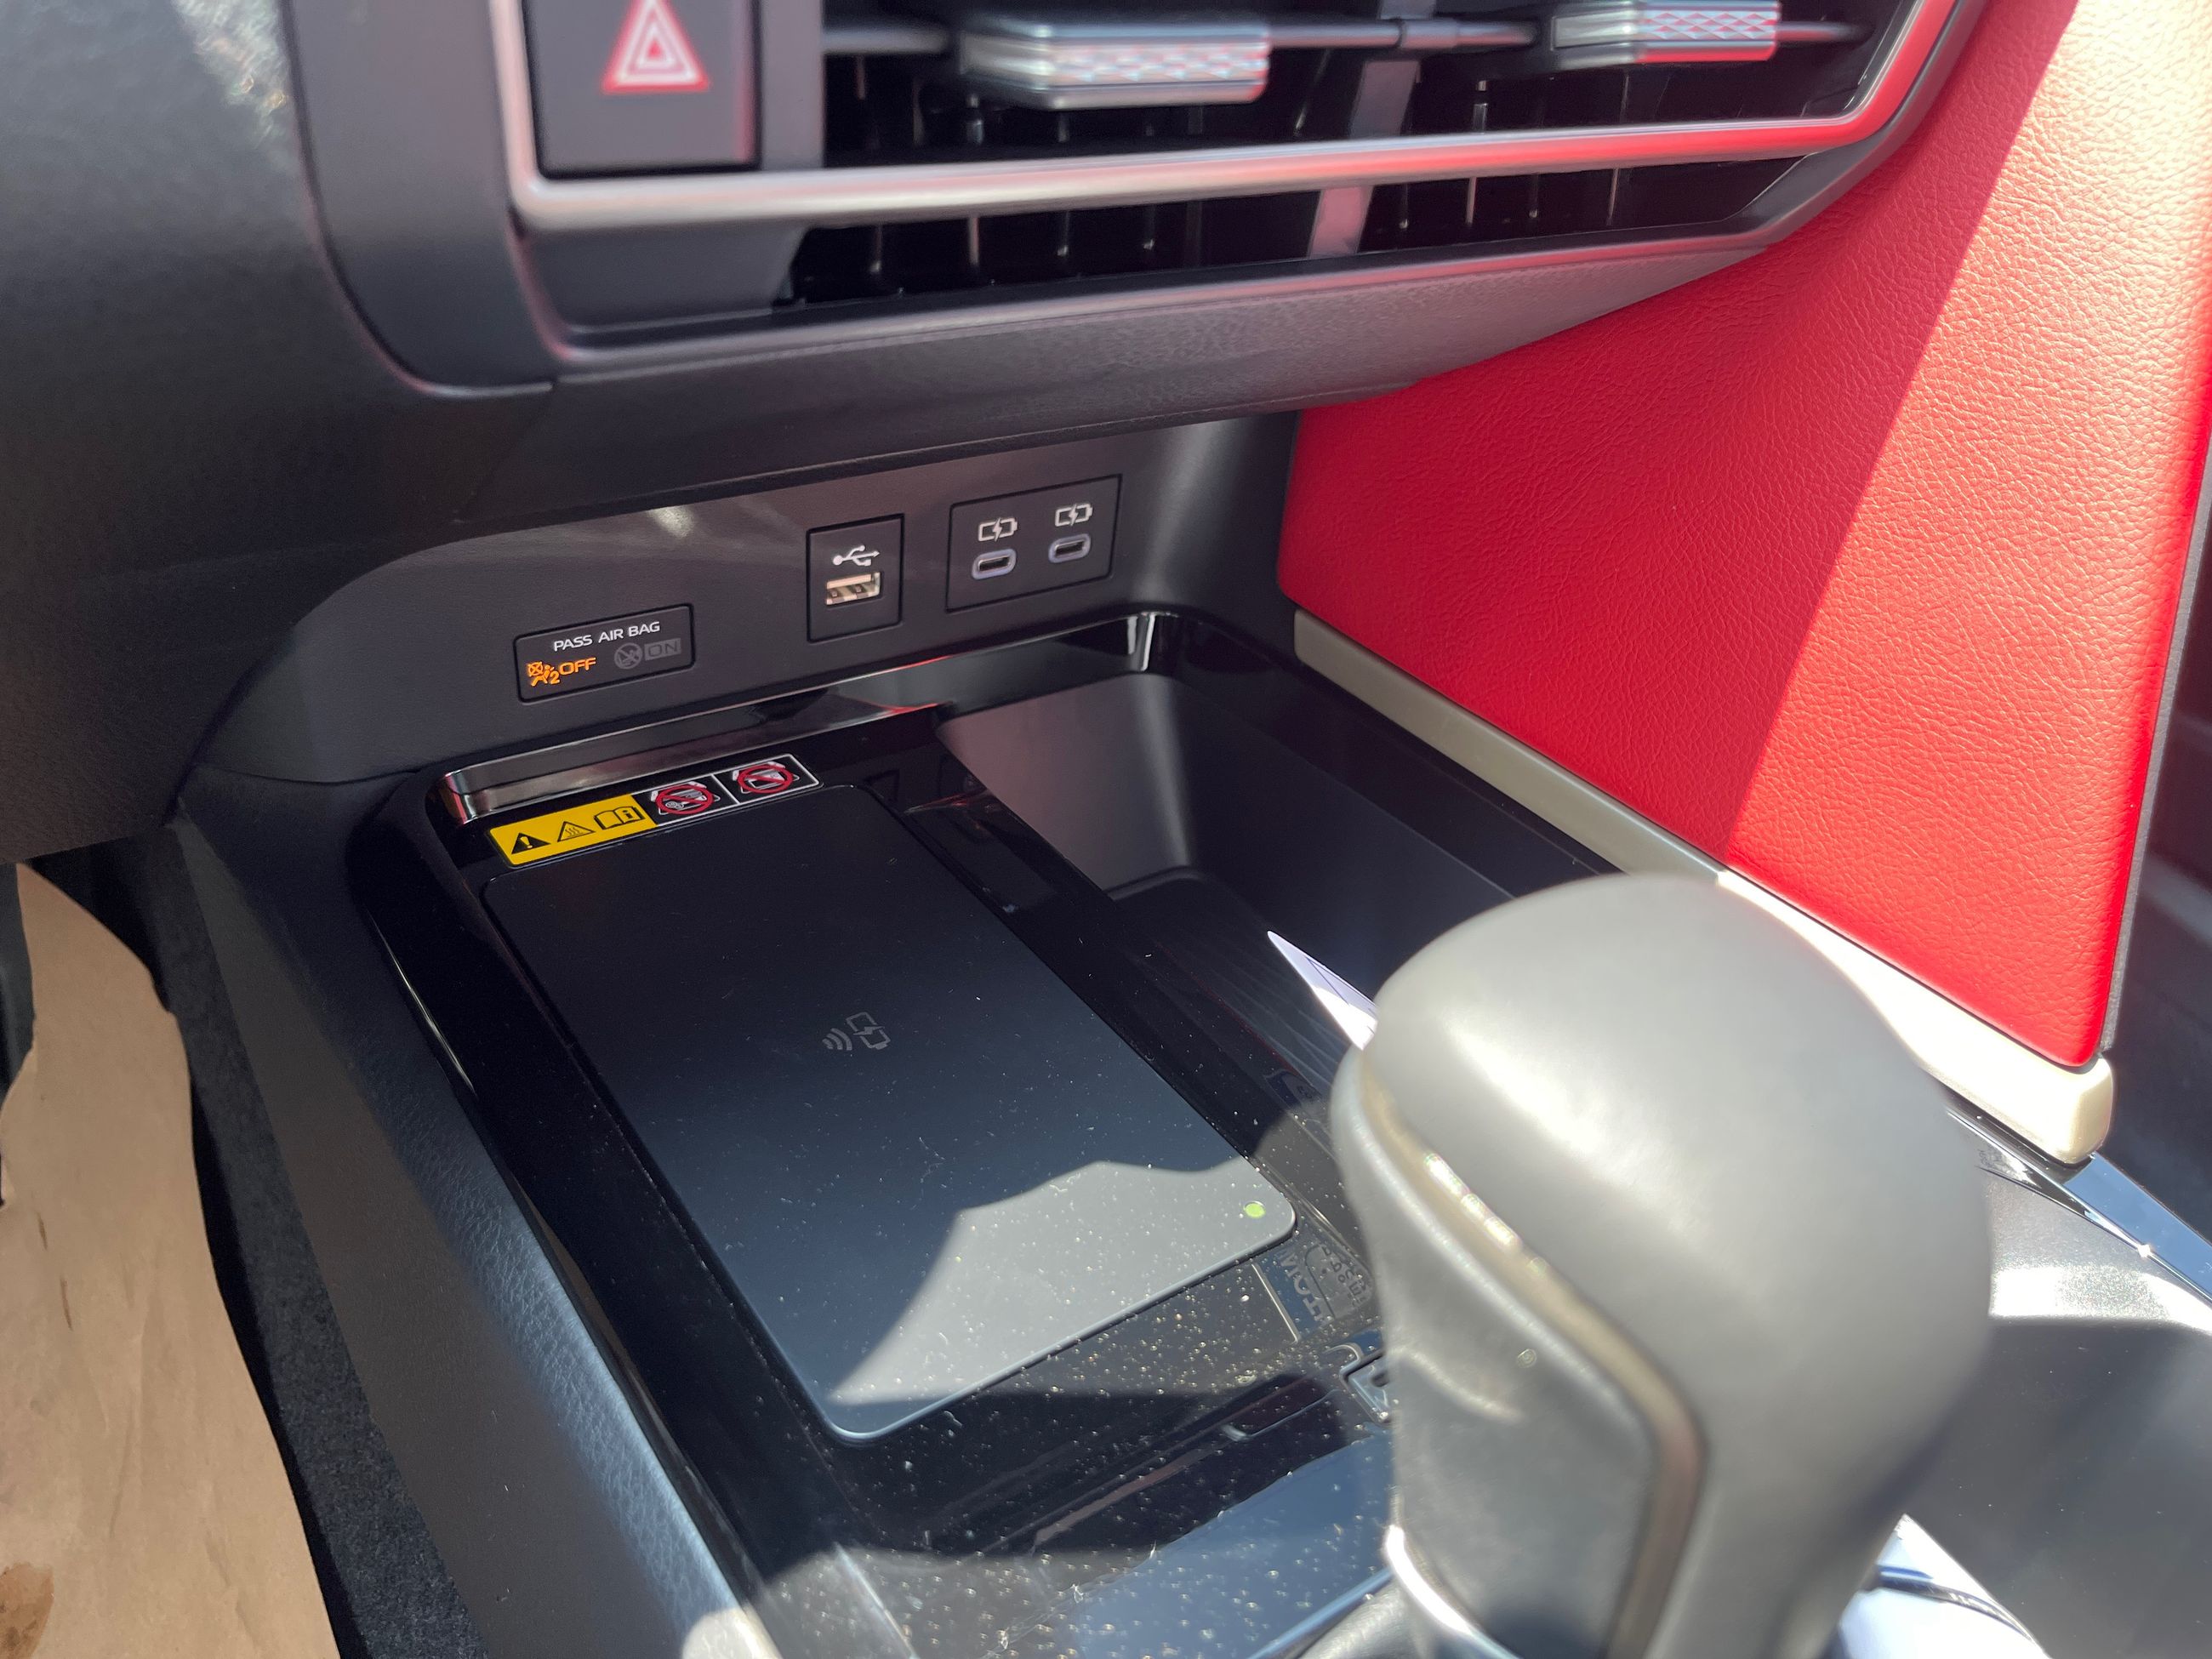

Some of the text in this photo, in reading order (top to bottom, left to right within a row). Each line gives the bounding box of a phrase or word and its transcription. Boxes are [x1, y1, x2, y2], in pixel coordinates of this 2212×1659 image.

[554, 621, 661, 652] PASS AIR BAG
[647, 640, 679, 658] ON
[559, 658, 596, 676] OFF
